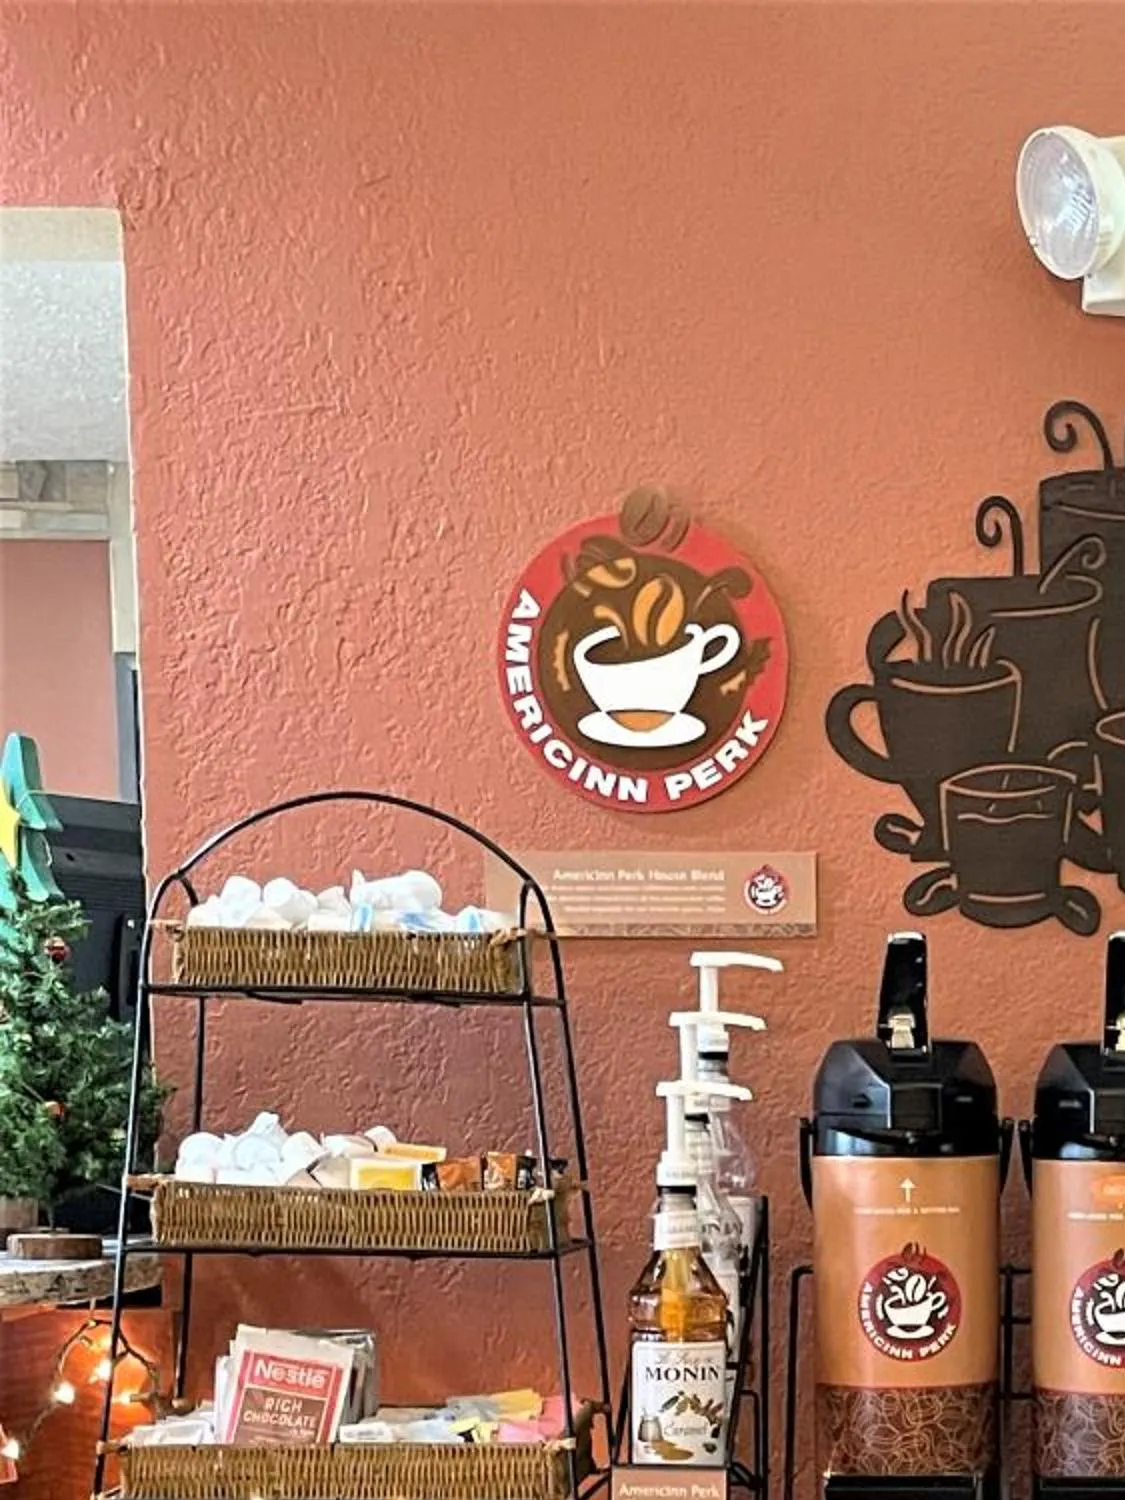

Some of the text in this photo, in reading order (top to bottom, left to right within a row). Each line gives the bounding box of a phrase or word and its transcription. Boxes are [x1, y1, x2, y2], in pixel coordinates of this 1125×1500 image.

[504, 588, 769, 802] AMERICINN PERK
[861, 1281, 957, 1359] AMERICINN PERK
[1071, 1286, 1122, 1365] AMERICINN
[646, 1366, 719, 1381] MONIN
[265, 1397, 303, 1412] RICH
[243, 1409, 316, 1428] CHOCOLATE
[691, 1484, 720, 1498] Perk
